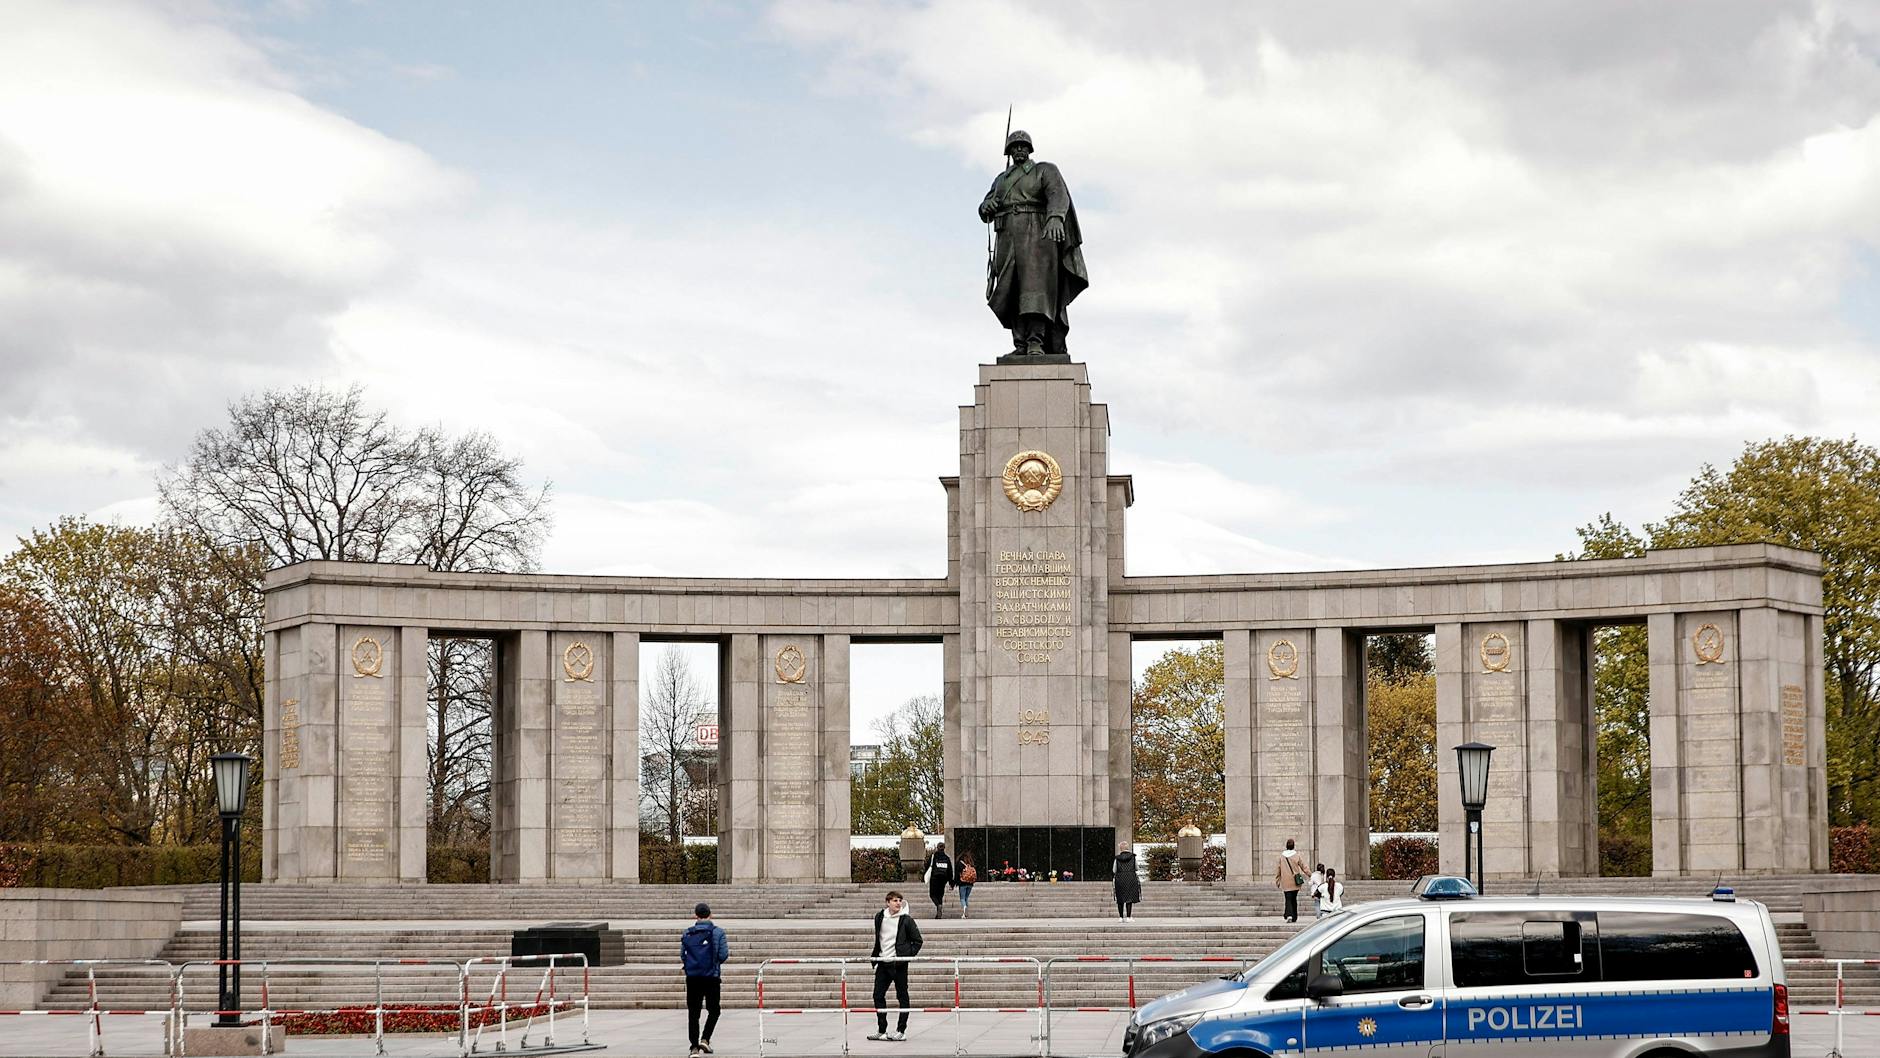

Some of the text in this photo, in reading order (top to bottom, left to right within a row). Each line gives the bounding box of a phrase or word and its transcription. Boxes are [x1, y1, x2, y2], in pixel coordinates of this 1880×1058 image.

[1000, 550, 1066, 561] ВЕЧНАЯ СЛАВА
[996, 563, 1071, 574] ГЕРОЯМ ПАВШИМ
[1002, 576, 1025, 586] БОЯХ
[996, 589, 1071, 599] ФАШИСТСКИМИ
[996, 602, 1071, 612] ЗАХВАТЧИКАМИ
[997, 615, 1009, 625] ЗА
[1012, 614, 1061, 625] СВОБОДУ
[996, 626, 1072, 638] НЕЗАВИСИМОСТЬ
[1003, 640, 1064, 651] СОВЕТСКОГО
[1017, 652, 1051, 663] СОЮЗА
[1017, 730, 1049, 745] 1945
[1468, 1004, 1583, 1031] POLIZEI
